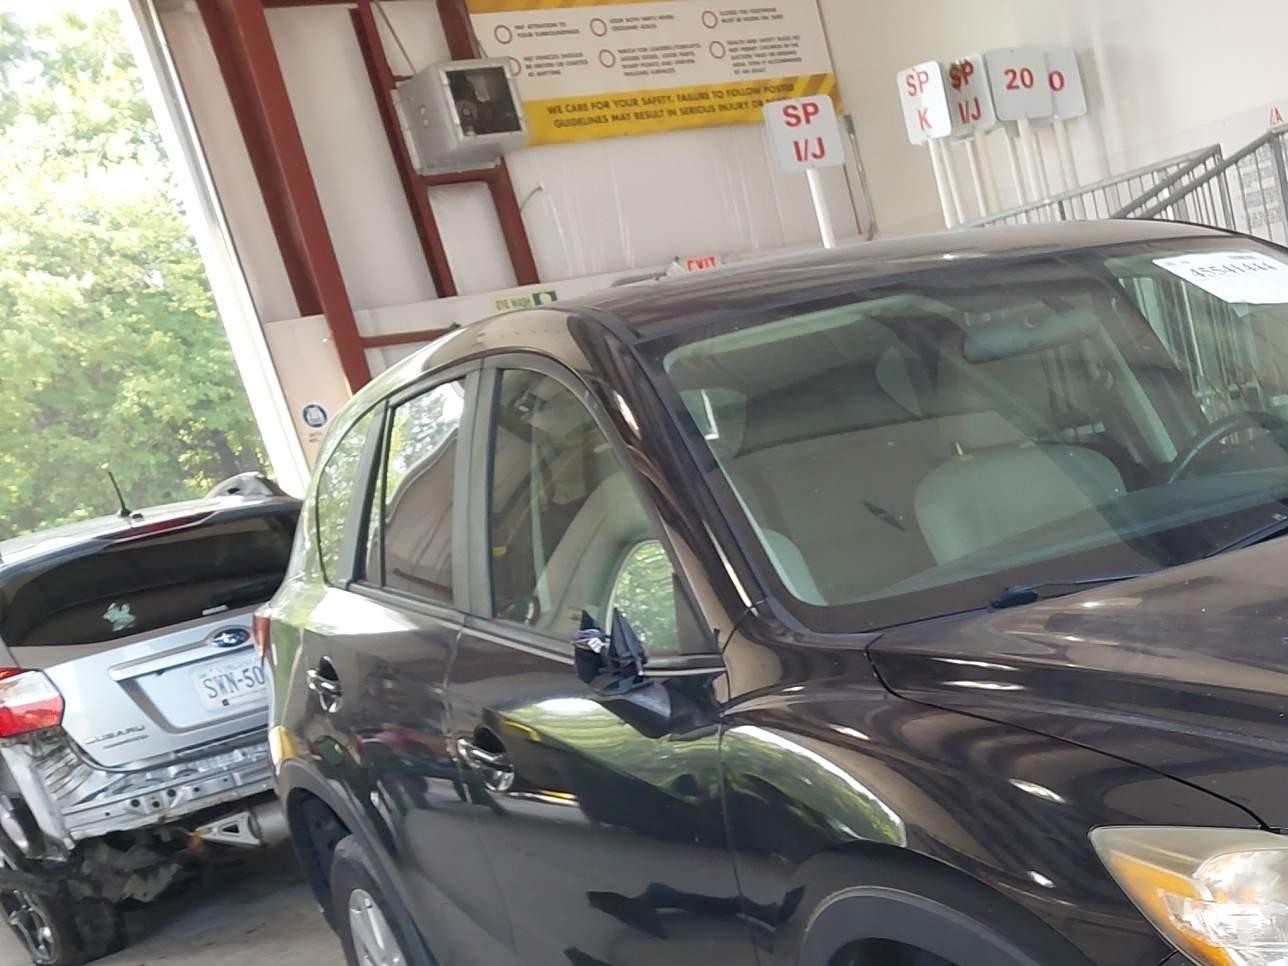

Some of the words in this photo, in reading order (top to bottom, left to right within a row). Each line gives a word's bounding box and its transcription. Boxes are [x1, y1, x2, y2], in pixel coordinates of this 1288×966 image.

[905, 70, 930, 97] SP
[949, 58, 974, 90] SP
[1004, 67, 1034, 90] 20
[546, 104, 563, 114] WE
[565, 102, 589, 113] CARE
[591, 100, 609, 110] FOR
[611, 98, 638, 108] YOUR
[677, 92, 709, 101] FAILURE
[712, 90, 724, 99] TO
[726, 87, 761, 98] FOLLOW
[958, 97, 982, 124] I/J
[553, 114, 609, 129] GUIDELINES
[611, 112, 631, 122] MAY
[634, 109, 664, 120] RESULT
[666, 107, 677, 117] IN
[680, 104, 716, 115] SERIOUS
[718, 101, 749, 112] INJURY
[751, 99, 764, 109] OR
[783, 102, 820, 128] SP
[917, 107, 933, 131] K
[793, 137, 827, 162] I/J
[1190, 262, 1278, 279] 45541444
